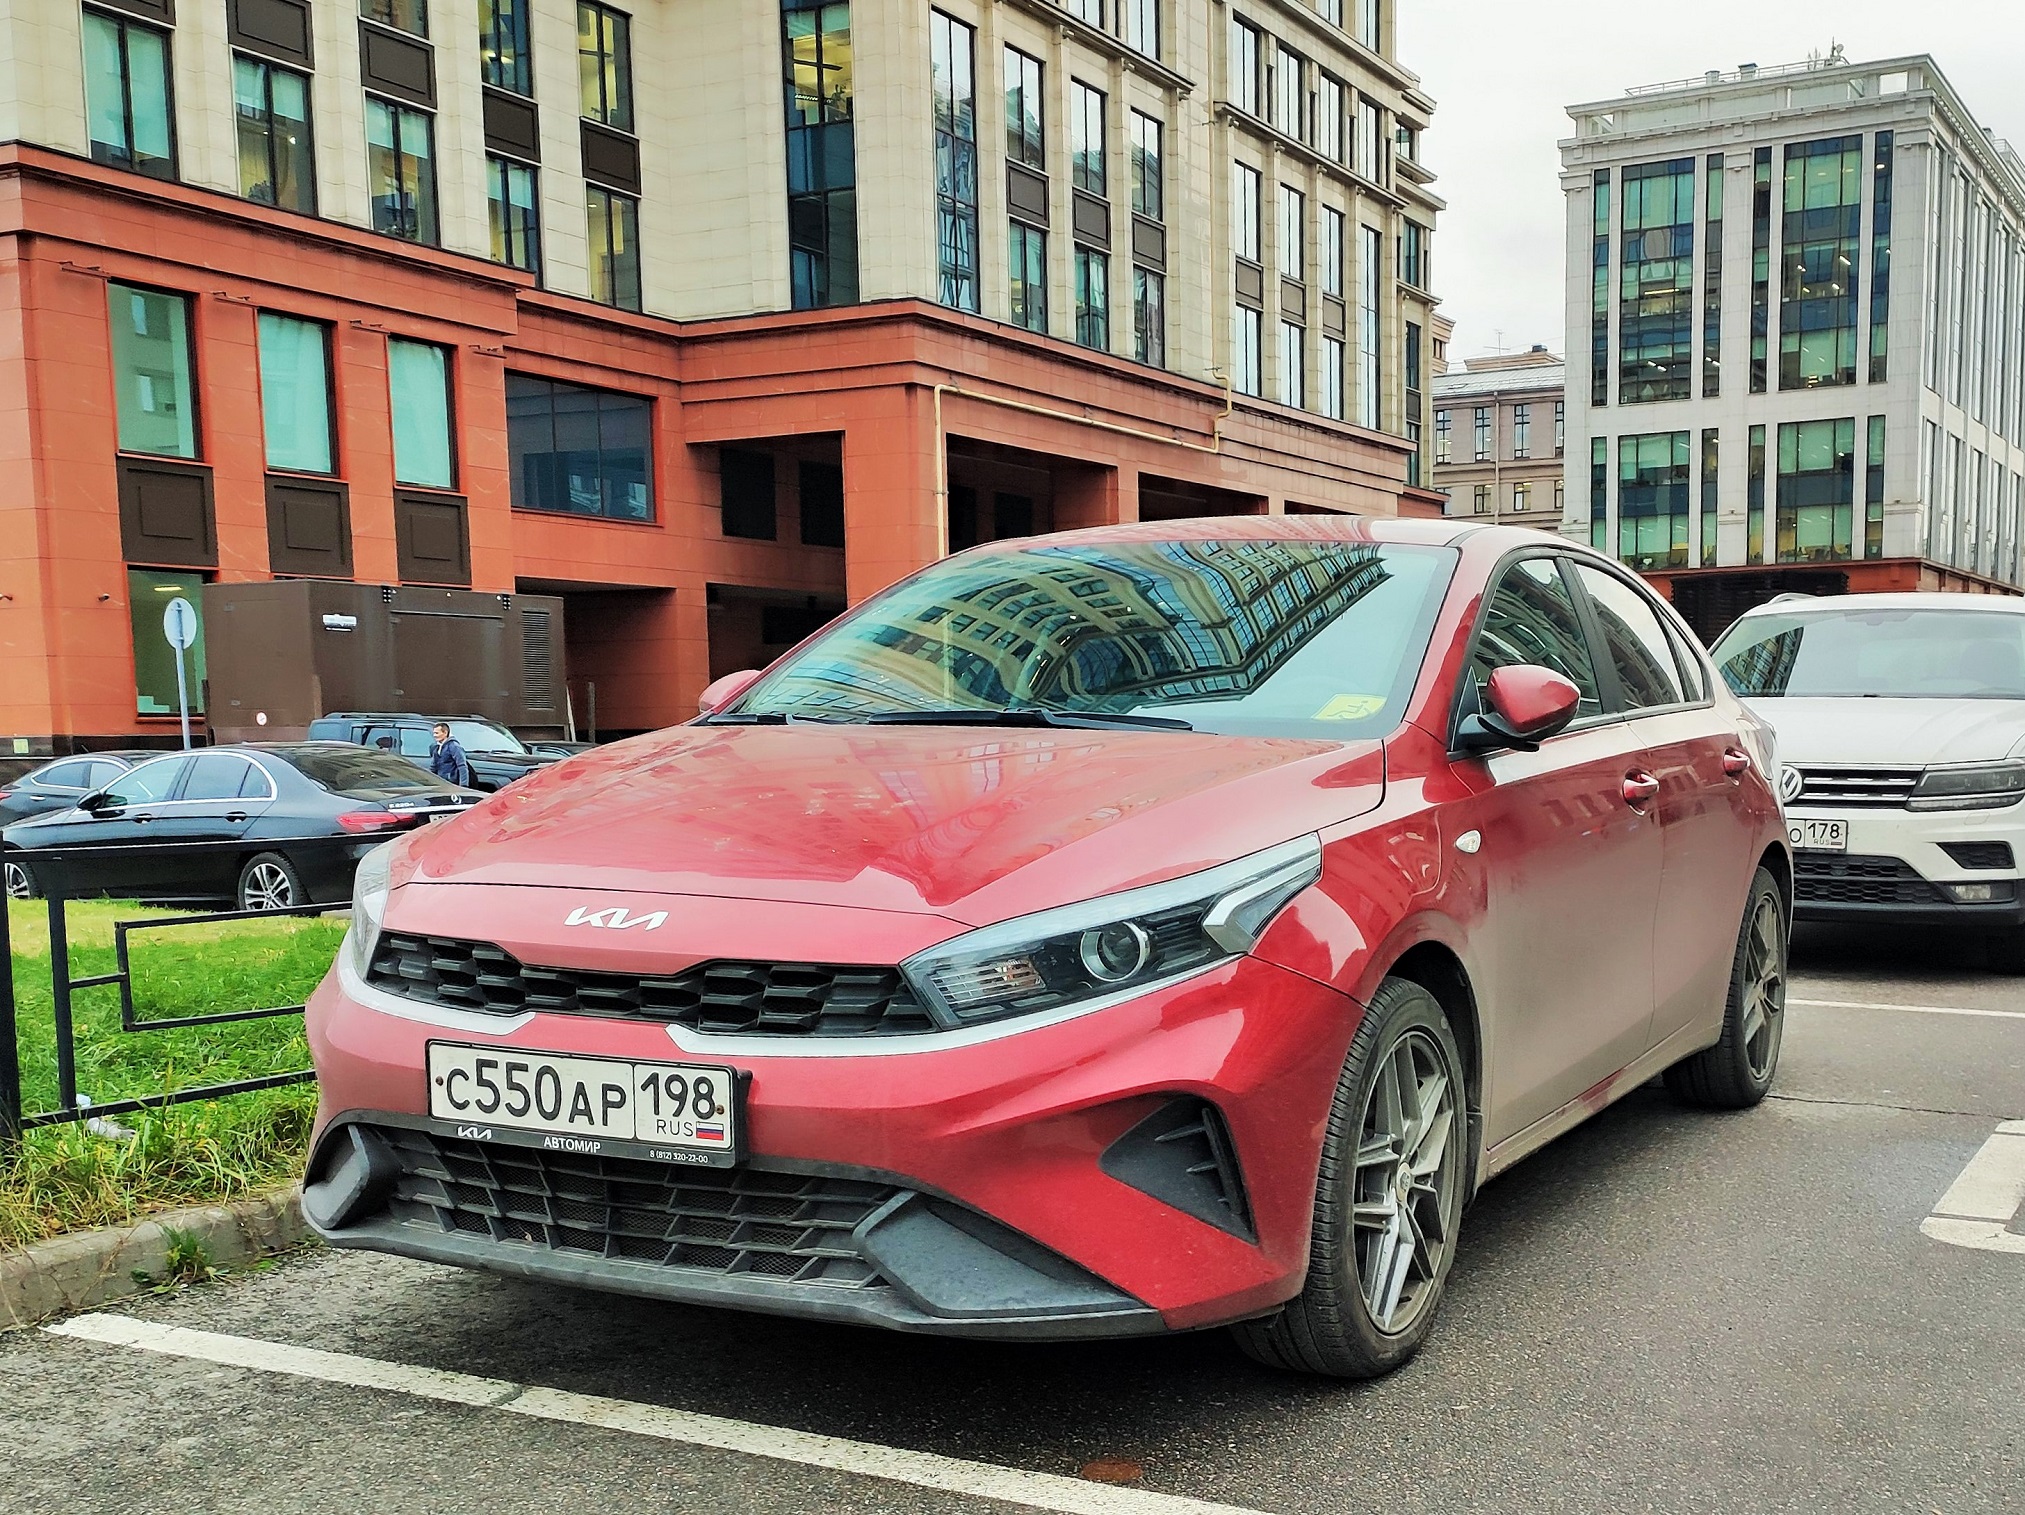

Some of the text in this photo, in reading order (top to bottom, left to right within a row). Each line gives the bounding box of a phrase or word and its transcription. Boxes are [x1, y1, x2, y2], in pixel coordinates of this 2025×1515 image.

[1807, 822, 1840, 838] 178
[563, 905, 669, 931] KIA
[640, 1071, 715, 1120] 198
[457, 1125, 492, 1141] KIA
[656, 1118, 694, 1137] RUS
[543, 1136, 601, 1153] АВТОМИР
[656, 1150, 672, 1160] (812)
[673, 1152, 708, 1163] 320-22-00
